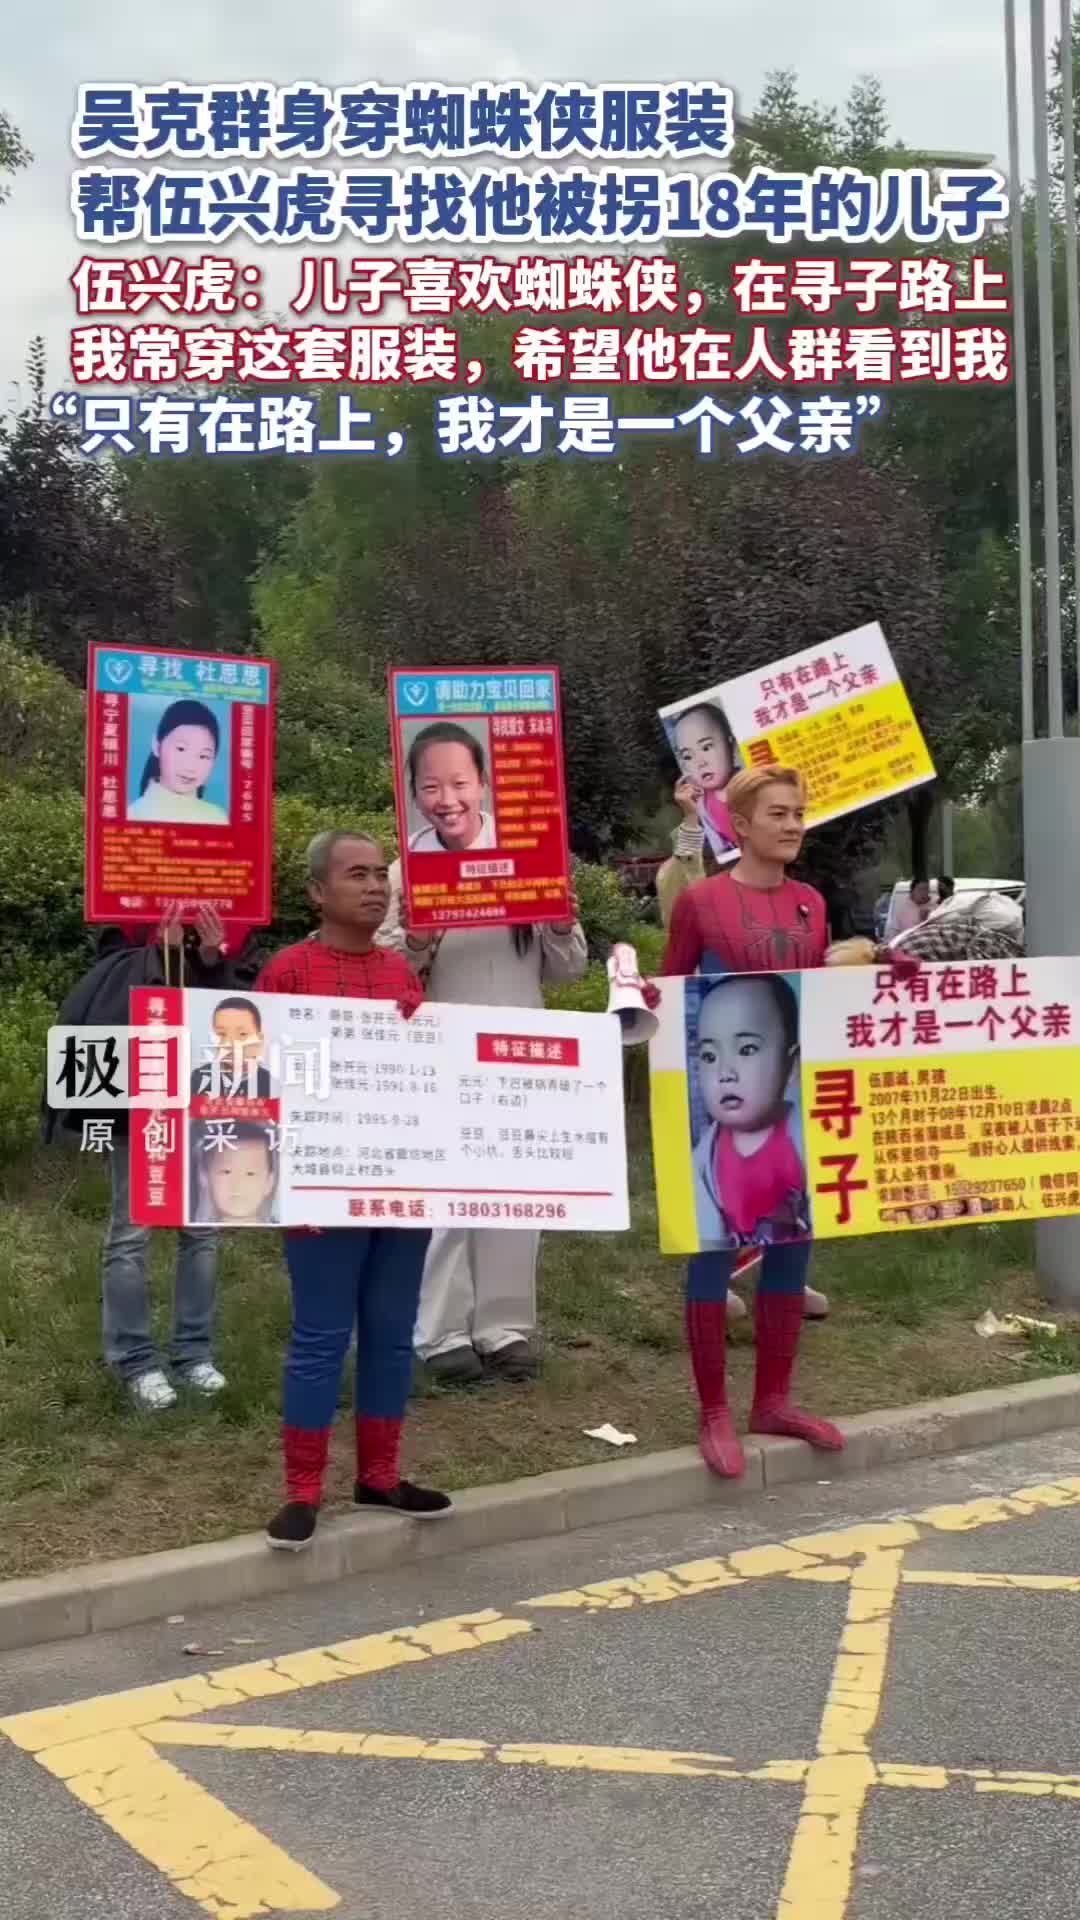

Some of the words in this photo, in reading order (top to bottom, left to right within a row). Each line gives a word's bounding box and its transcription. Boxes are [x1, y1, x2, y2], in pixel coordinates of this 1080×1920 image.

[138, 656, 183, 680] 寻找
[759, 651, 849, 702] 只有在路上
[753, 664, 880, 729] 我才是一个父亲
[873, 964, 1032, 1006] 只有在路上
[845, 1002, 1073, 1049] 我才是一个父亲
[491, 1039, 564, 1060] 特征描述
[810, 1068, 869, 1226] 寻子
